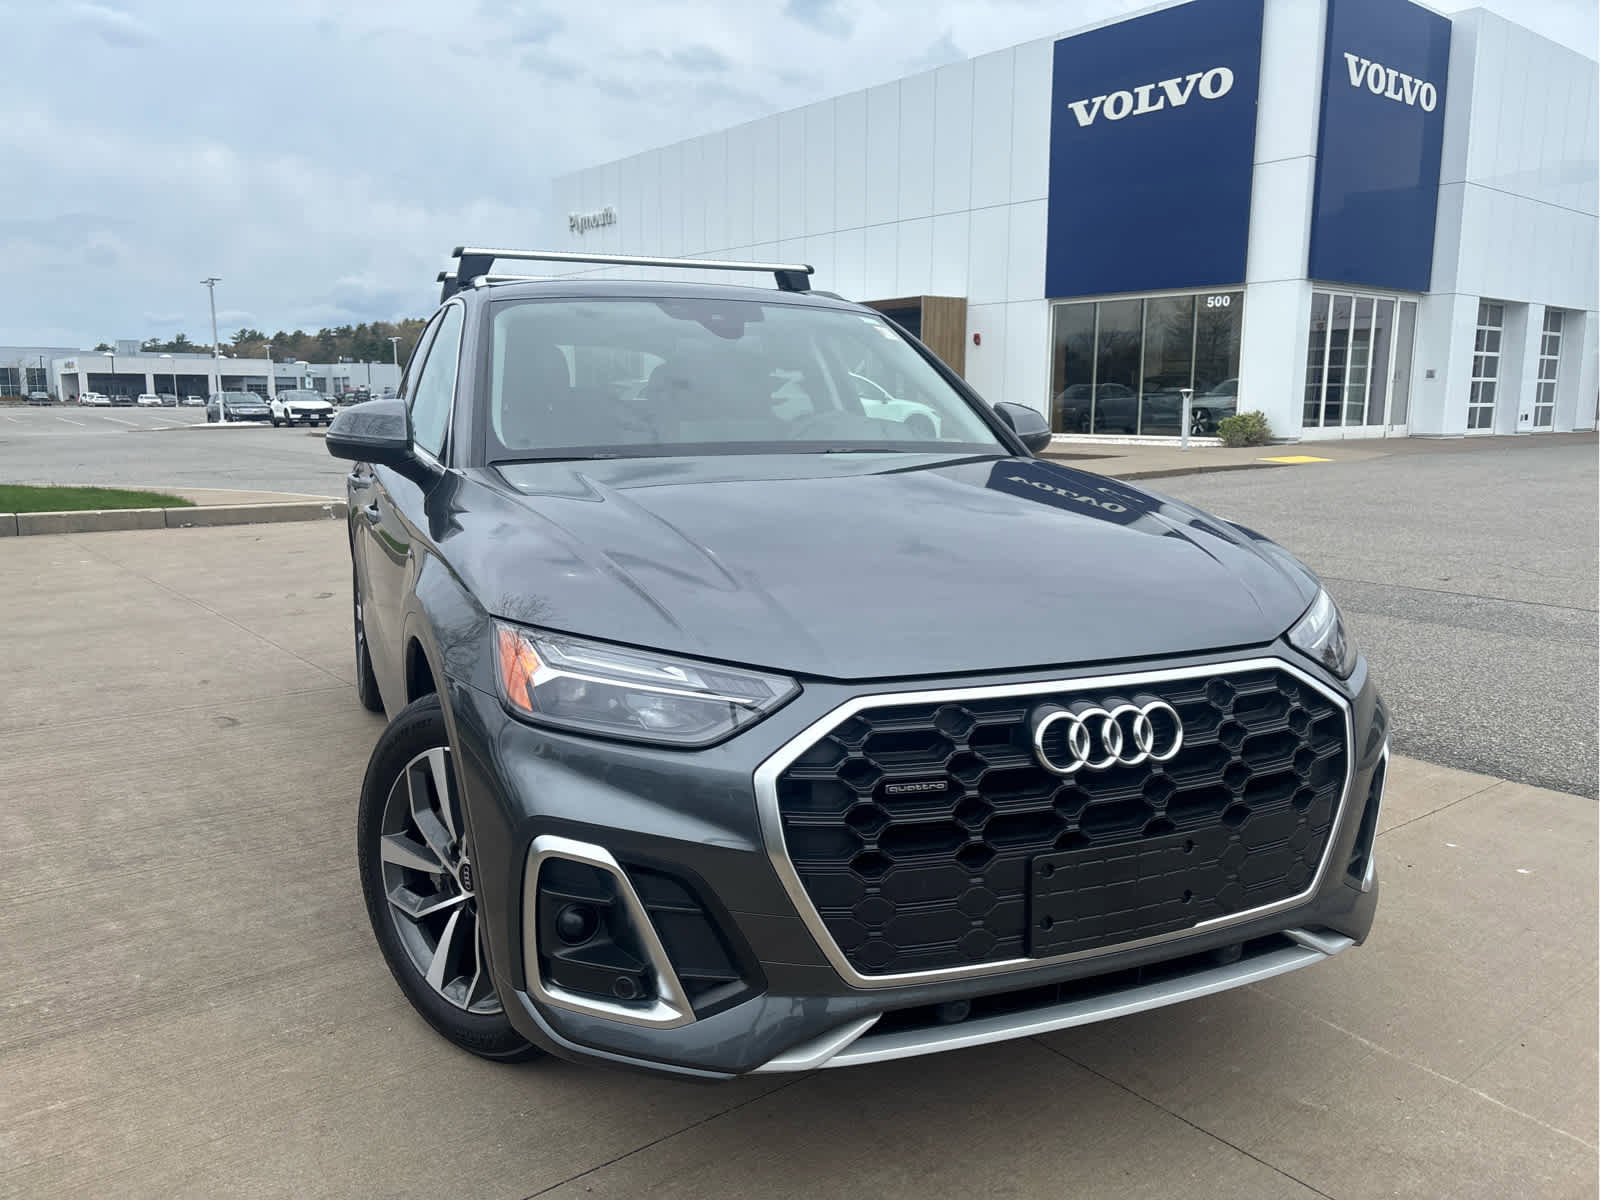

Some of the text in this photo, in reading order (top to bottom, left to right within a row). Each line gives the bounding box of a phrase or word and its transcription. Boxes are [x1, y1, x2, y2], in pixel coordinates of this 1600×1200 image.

[1344, 52, 1437, 112] VOLVO
[1068, 67, 1234, 127] VOLVO
[568, 207, 616, 235] Plymouth
[1207, 295, 1230, 307] 500
[888, 783, 945, 793] quattro
